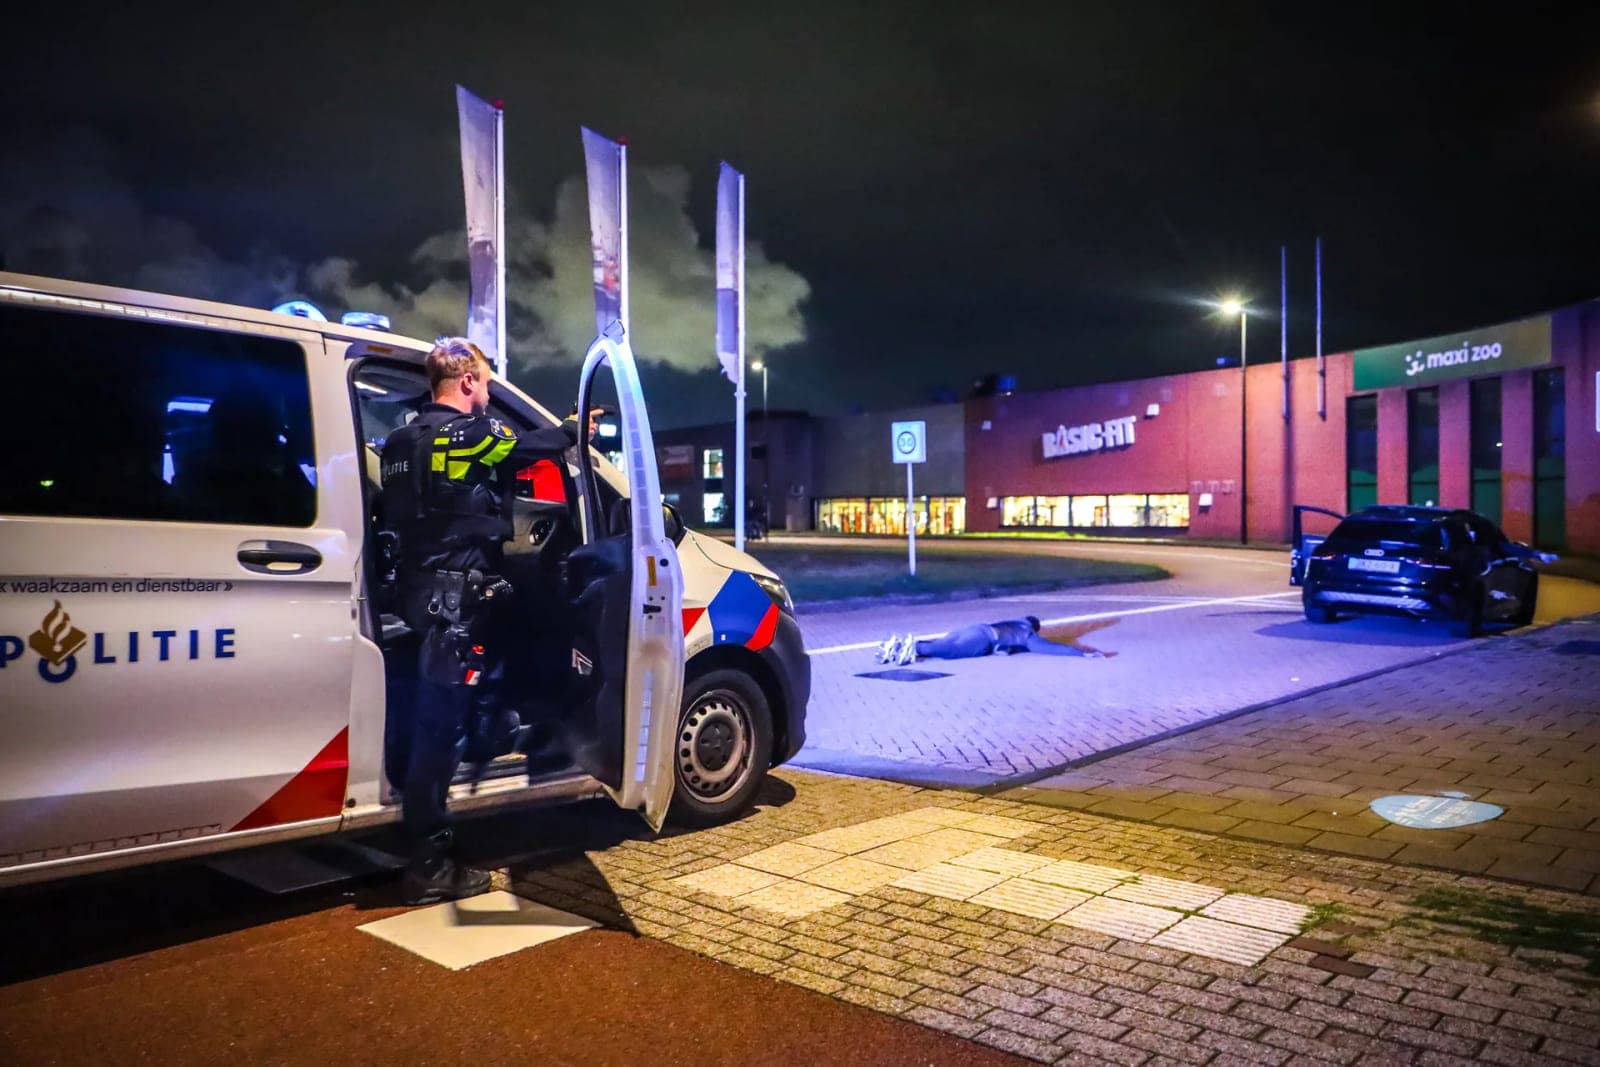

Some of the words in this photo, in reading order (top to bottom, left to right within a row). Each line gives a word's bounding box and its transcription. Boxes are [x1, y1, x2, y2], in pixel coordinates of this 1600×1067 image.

[1427, 341, 1469, 368] maxi
[1471, 342, 1502, 361] zoo
[1042, 415, 1137, 458] BASIC-FIT
[11, 577, 108, 593] waakzaam
[112, 581, 133, 592] en
[136, 578, 222, 592] dienstbaar
